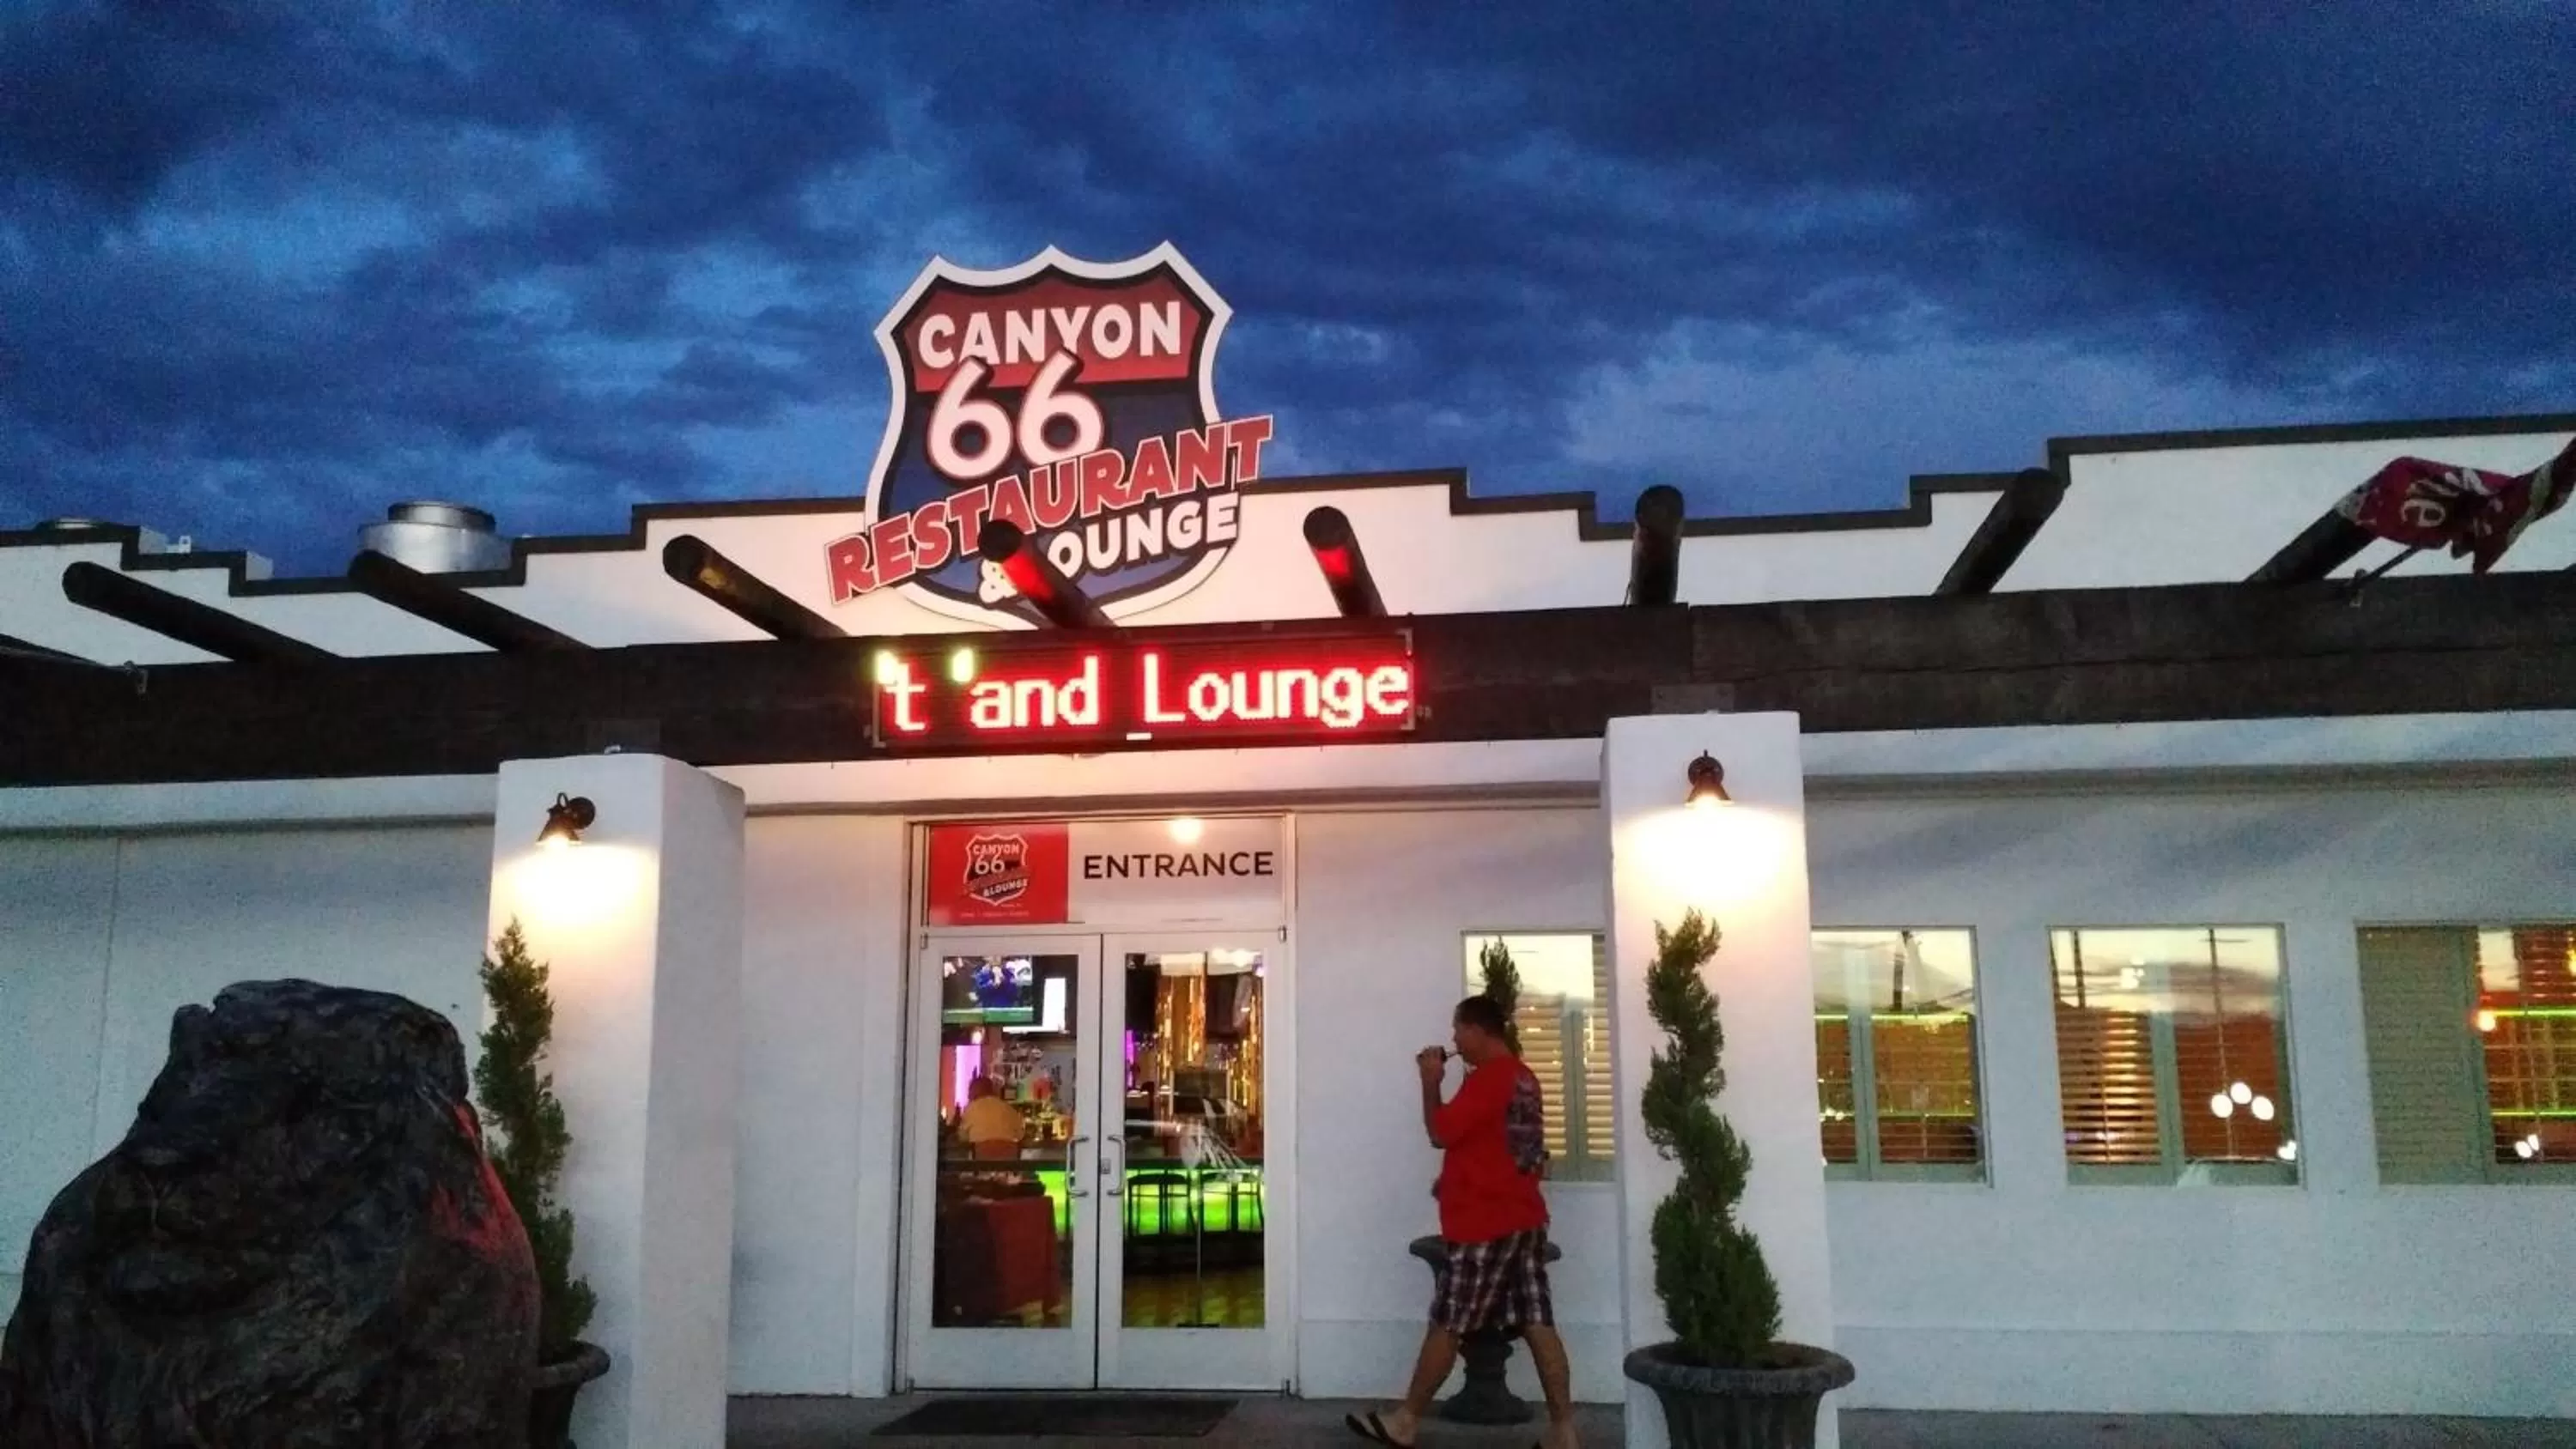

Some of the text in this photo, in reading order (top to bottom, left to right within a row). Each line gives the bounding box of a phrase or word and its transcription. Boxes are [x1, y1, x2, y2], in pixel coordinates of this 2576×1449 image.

[918, 300, 1182, 370] CANYON
[928, 349, 1105, 480] 66
[827, 415, 1274, 605] RESTAURANT
[1048, 491, 1239, 579] OUNGE
[969, 656, 1100, 729] and
[1144, 653, 1409, 729] Lounge
[973, 844, 1019, 856] CANYON
[975, 850, 1005, 876] 66
[1084, 851, 1274, 880] ENTRANCE
